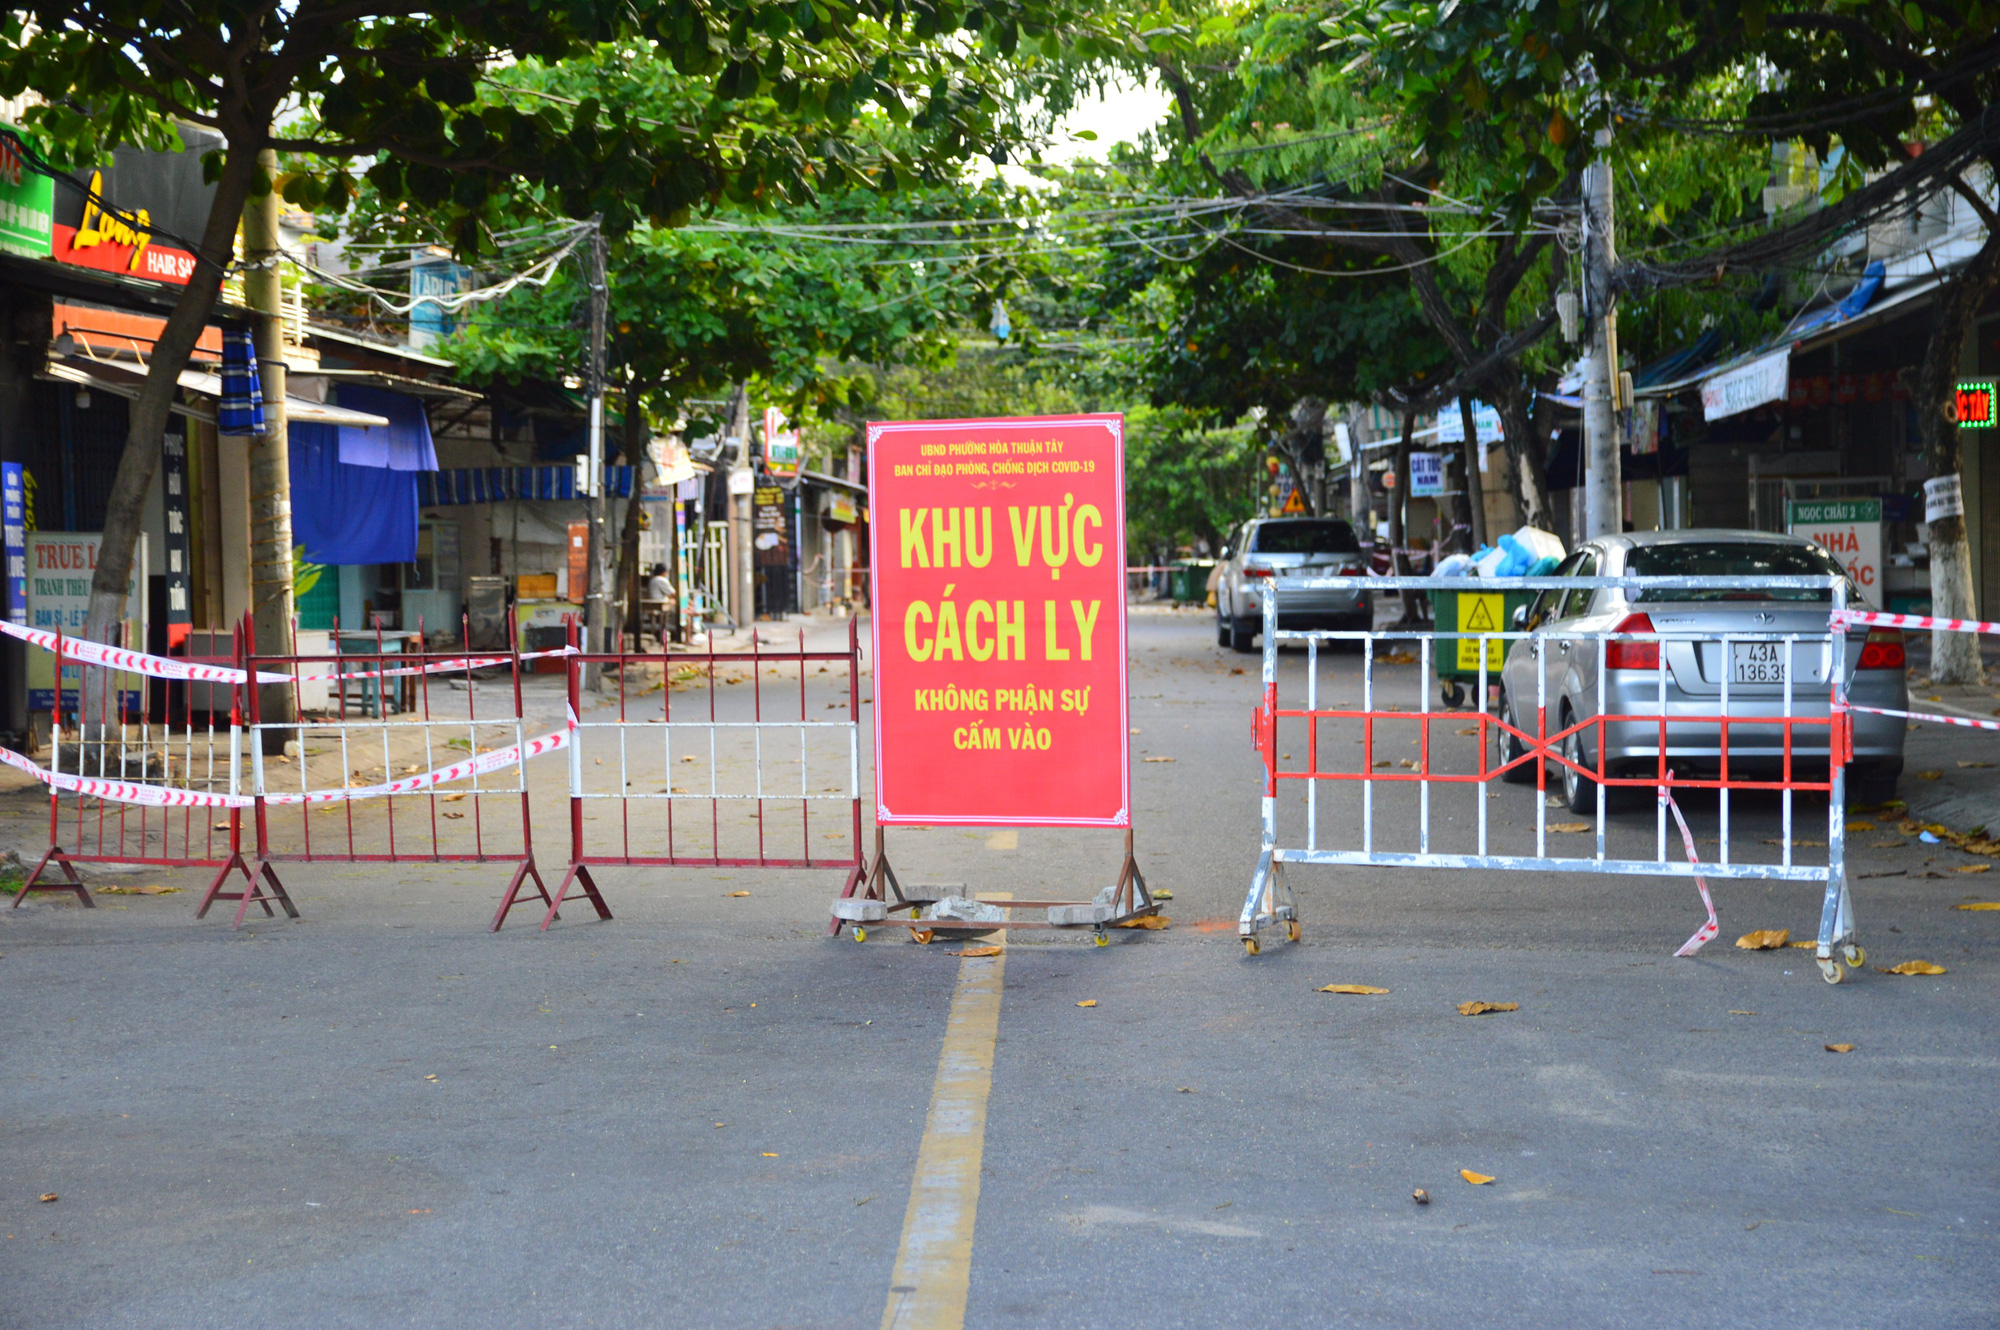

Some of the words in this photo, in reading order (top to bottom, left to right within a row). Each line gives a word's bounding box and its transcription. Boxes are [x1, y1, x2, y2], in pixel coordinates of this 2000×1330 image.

[147, 251, 176, 276] HAIR
[1968, 389, 1990, 421] TÂY
[921, 443, 946, 456] UBND
[949, 440, 987, 456] PHƯỜNG
[989, 439, 1008, 454] HÒA
[1011, 439, 1042, 456] THUẬN
[1045, 438, 1064, 453] TÂY
[894, 464, 913, 476] BAN
[916, 459, 932, 476] CHỈ
[934, 463, 953, 478] ĐẠO
[956, 460, 990, 476] PHÒNG,
[992, 458, 1024, 474] CHỐNG
[1027, 461, 1049, 476] DỊCH
[1052, 460, 1095, 474] COVID-19
[1417, 475, 1438, 486] NAM
[1850, 506, 1856, 519] 2
[899, 506, 993, 568] KHU
[1008, 492, 1103, 580] VỰC
[35, 544, 83, 569] TRUE
[34, 579, 63, 596] TRANH
[904, 584, 1026, 662] CÁCH
[1044, 600, 1101, 661] LY
[1748, 645, 1777, 662] 43A
[915, 683, 989, 711] KHÔNG
[995, 683, 1054, 716] PHẬN
[1060, 685, 1091, 716] SỰ
[954, 719, 1001, 749] CẤM
[1008, 722, 1051, 750] VÀO
